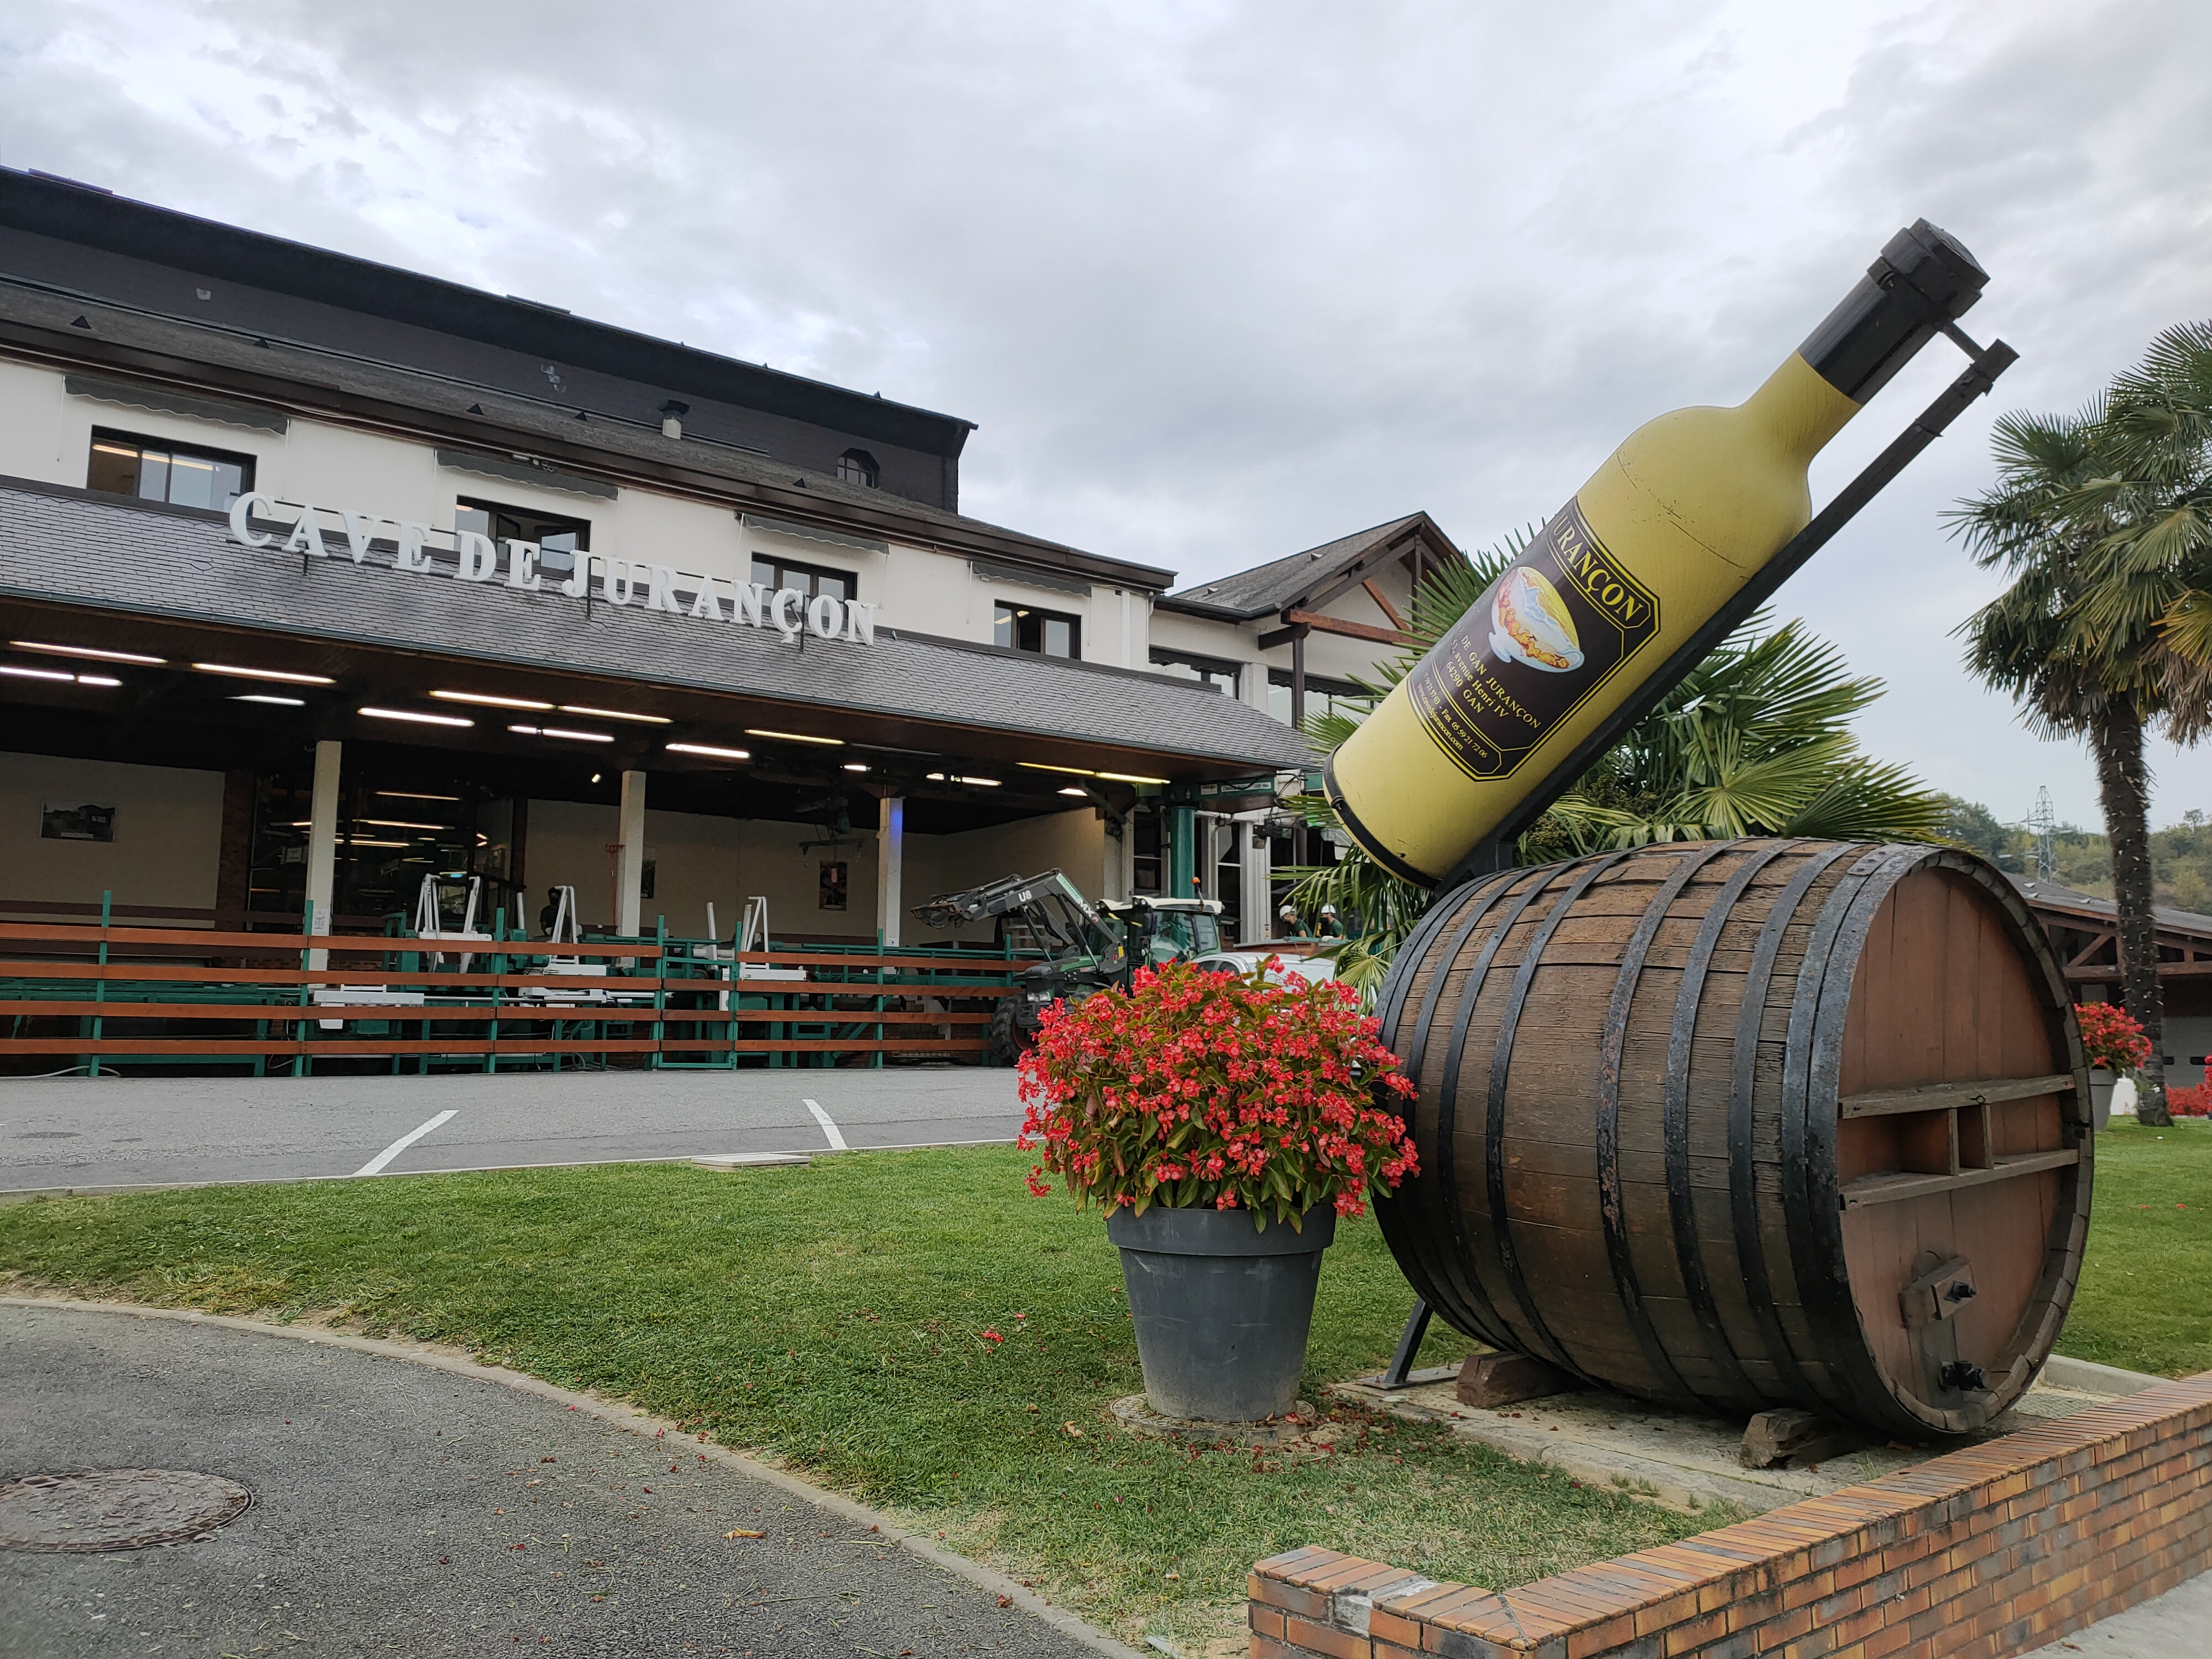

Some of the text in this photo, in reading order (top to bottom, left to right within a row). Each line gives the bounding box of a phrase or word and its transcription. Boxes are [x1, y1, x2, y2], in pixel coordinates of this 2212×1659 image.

[229, 492, 877, 646] CAVE DE JURANÇON
[1446, 661, 1485, 713] 64290 GAN
[1454, 652, 1473, 681] avenue
[1472, 680, 1495, 707] Henri
[1494, 704, 1509, 717] IV
[1462, 635, 1541, 729] DE GAN JURANÇON
[1441, 708, 1452, 723] Fax
[1451, 721, 1460, 731] 05
[1457, 729, 1467, 738] 59
[1464, 736, 1473, 745] 21
[1472, 742, 1480, 752] 72
[1479, 749, 1489, 759] 06
[1019, 890, 1032, 902] U8
[1077, 898, 1095, 919] MX
